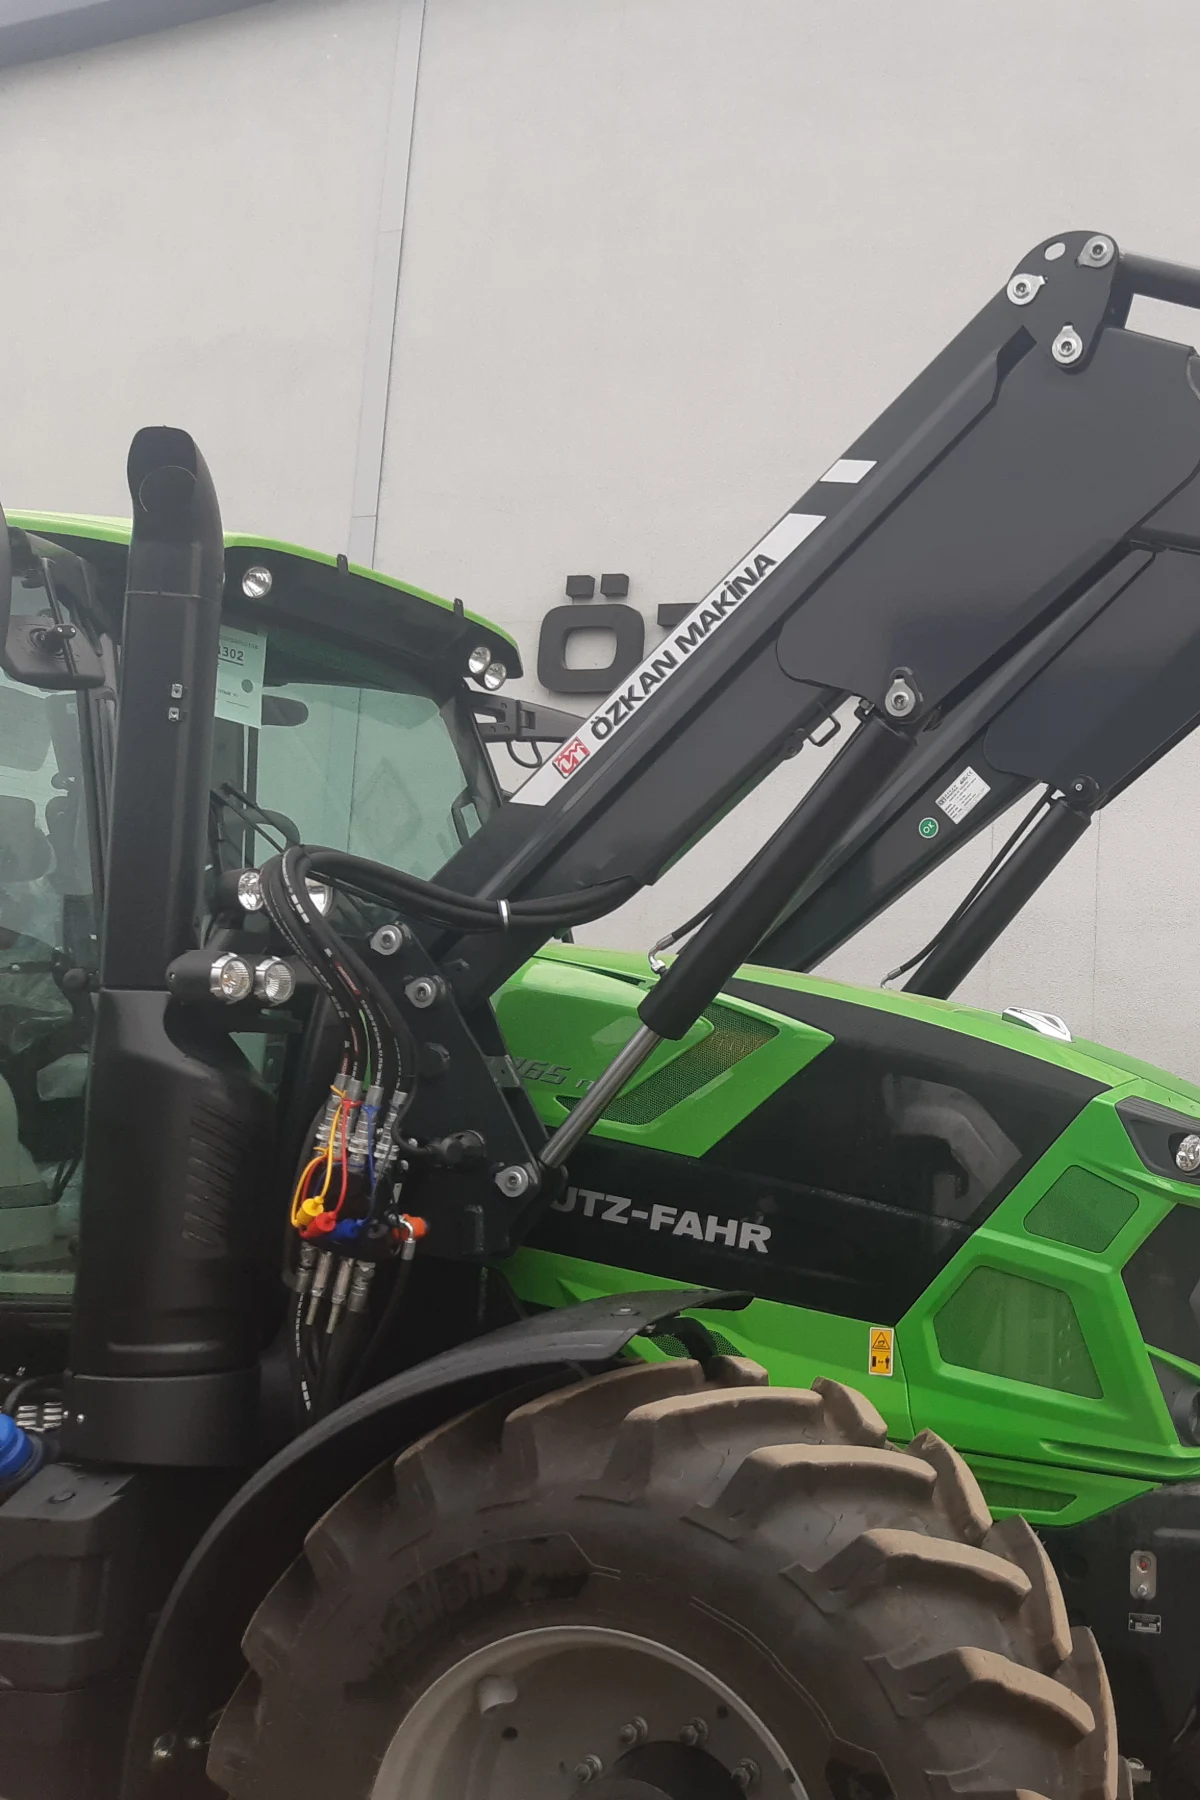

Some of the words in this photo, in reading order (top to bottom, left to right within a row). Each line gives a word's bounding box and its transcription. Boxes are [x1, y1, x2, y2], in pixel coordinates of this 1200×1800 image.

[590, 650, 679, 740] ÖZKAN
[674, 554, 778, 654] MAKİNA
[923, 822, 935, 834] OK
